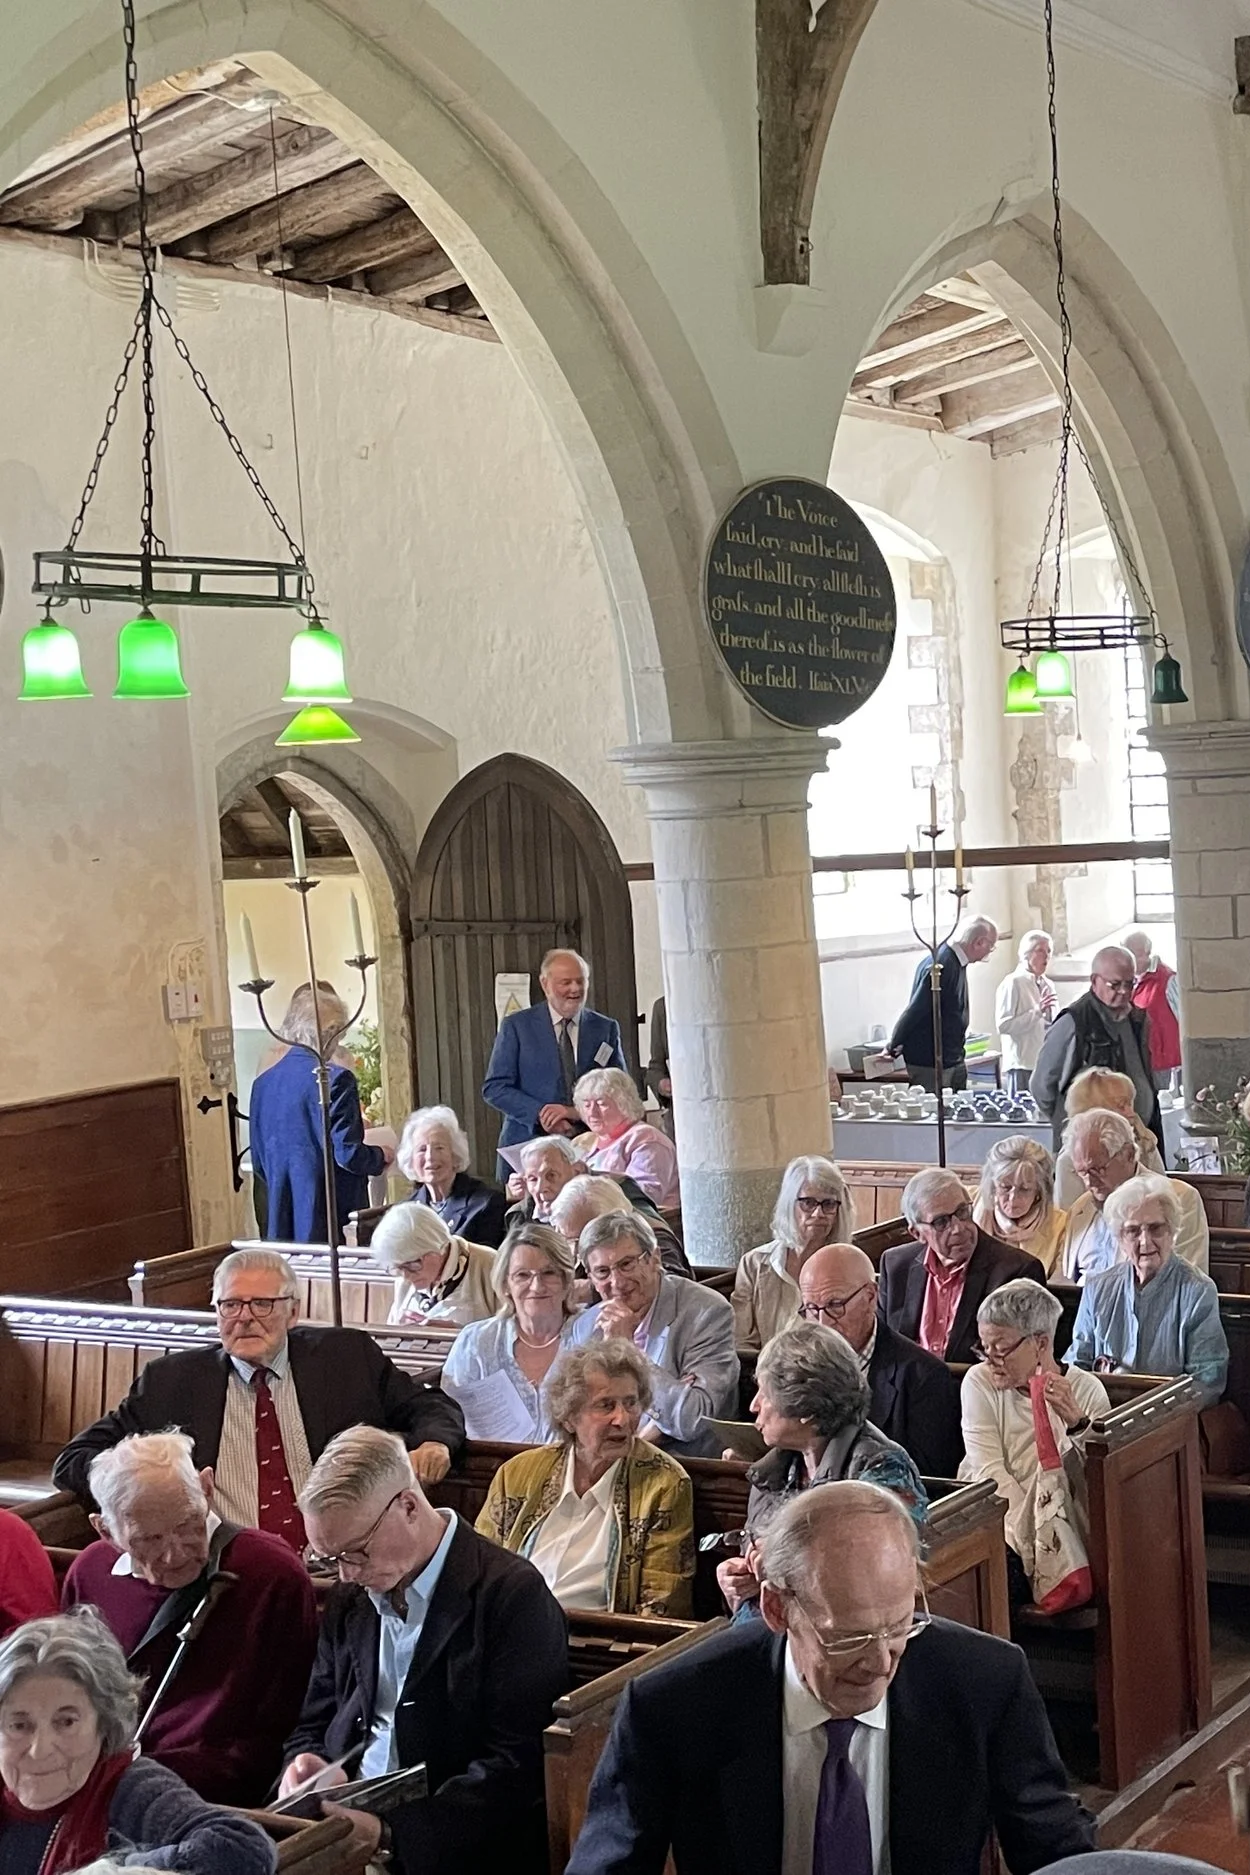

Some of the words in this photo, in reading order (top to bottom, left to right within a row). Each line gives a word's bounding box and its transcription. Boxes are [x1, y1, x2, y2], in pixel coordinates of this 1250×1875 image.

[796, 498, 839, 529] Voice
[789, 533, 817, 556] and
[817, 535, 835, 558] he
[712, 552, 752, 579] what
[822, 568, 840, 593] all
[869, 575, 882, 599] is
[754, 594, 782, 618] and
[786, 597, 804, 621] all
[807, 600, 829, 622] the
[787, 640, 805, 655] as
[808, 633, 830, 657] the
[831, 636, 870, 663] flower
[740, 660, 763, 686] the
